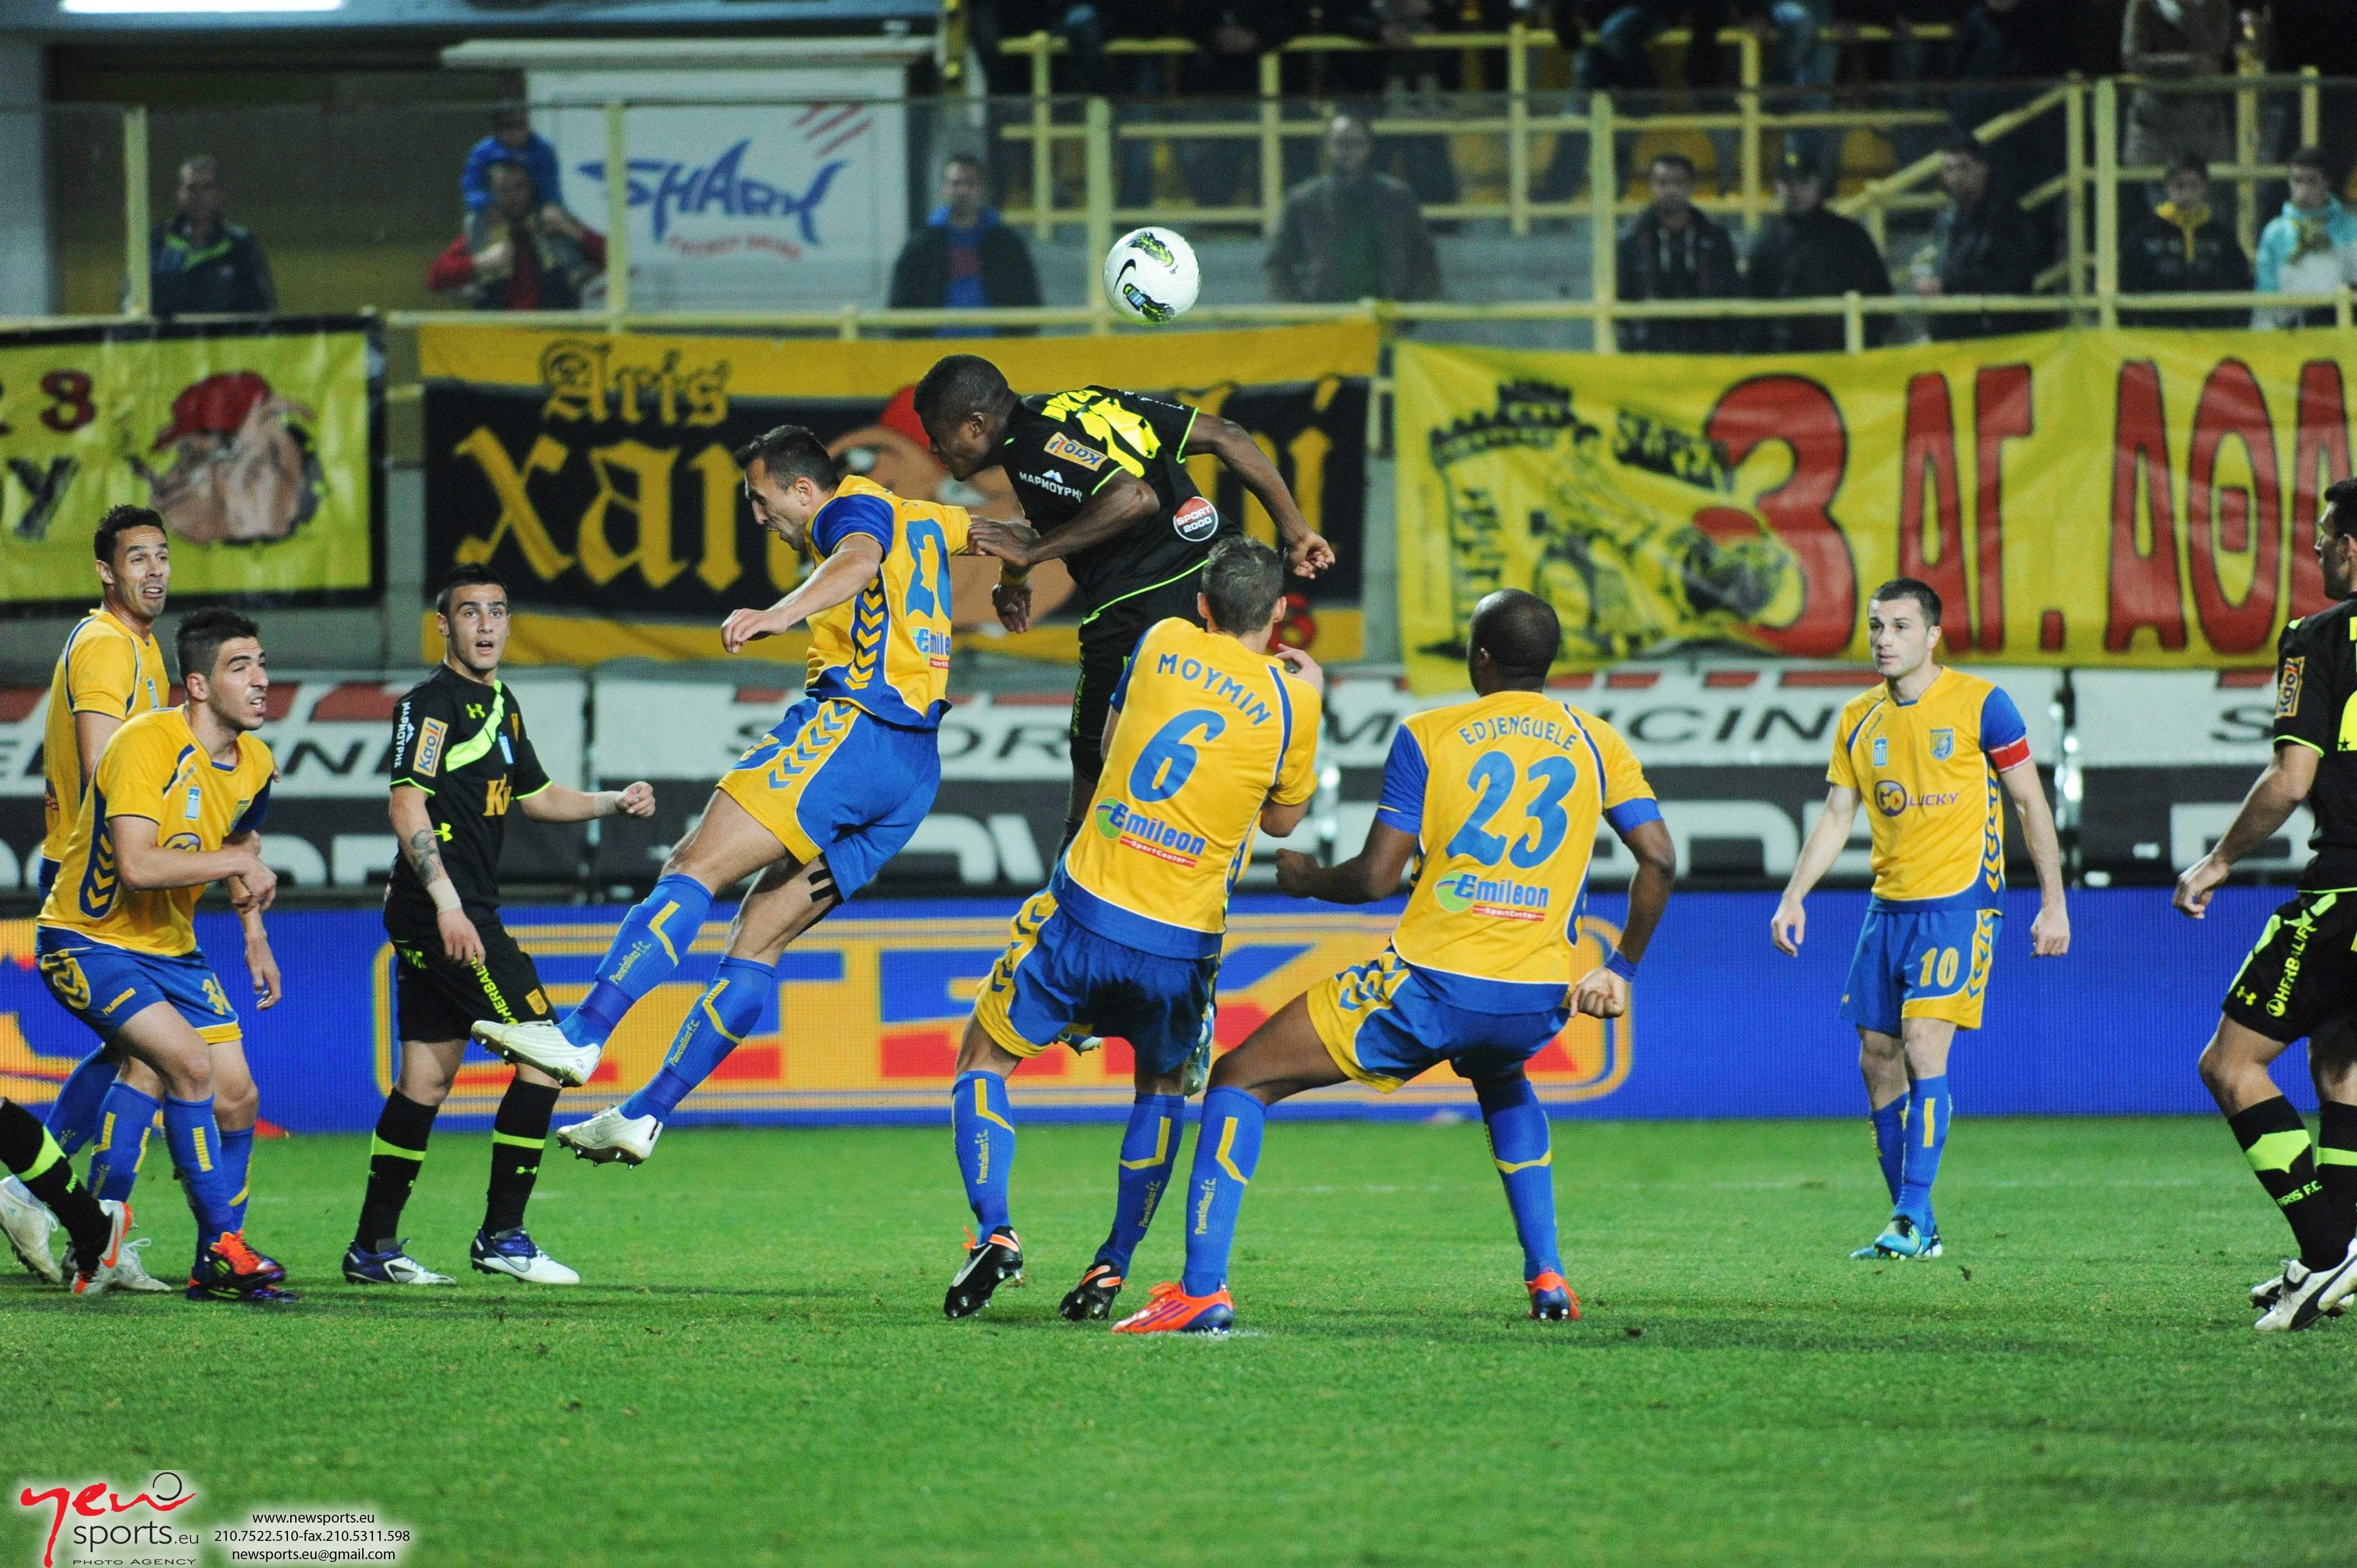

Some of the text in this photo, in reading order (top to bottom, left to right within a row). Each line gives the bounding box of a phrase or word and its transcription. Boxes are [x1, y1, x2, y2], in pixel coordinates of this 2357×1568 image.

[576, 137, 846, 245] SHARK
[539, 339, 731, 426] Aris
[1176, 506, 1211, 525] SPORT
[1183, 517, 1212, 533] 2000
[1704, 372, 1857, 657] 3
[1157, 653, 1272, 726] MOYMIN
[418, 721, 440, 772] Kaoil
[1129, 709, 1226, 802] 6
[1458, 715, 1577, 751] EDJENGUELE
[1445, 750, 1577, 868] 23
[1909, 793, 1959, 806] LUCKY
[1108, 802, 1206, 857] Emileon
[1130, 840, 1186, 863] SportCenter
[1454, 873, 1549, 908] Emileon
[1919, 947, 1959, 988] 10
